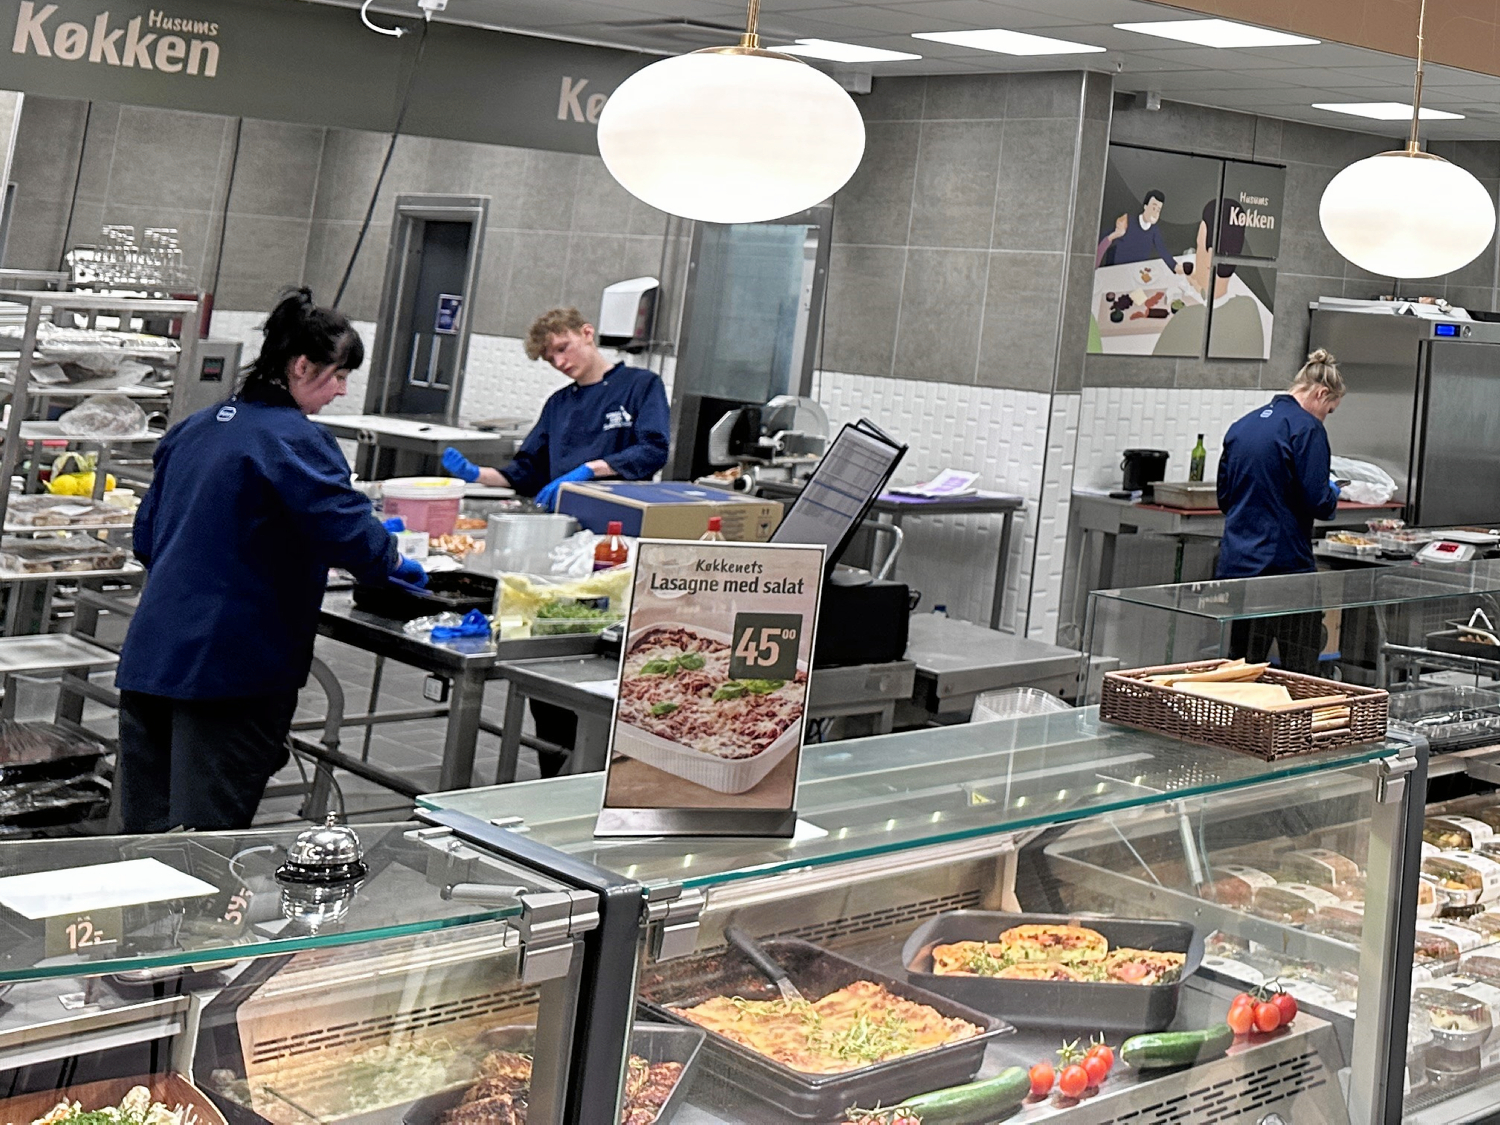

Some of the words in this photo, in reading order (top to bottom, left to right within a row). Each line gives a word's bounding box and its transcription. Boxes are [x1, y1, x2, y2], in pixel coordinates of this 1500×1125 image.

[149, 9, 219, 36] Husums
[12, 0, 220, 77] Køkken
[1229, 206, 1275, 229] Køkken
[695, 558, 763, 574] Køkkenets
[650, 572, 719, 595] Lasagne
[723, 576, 759, 593] med
[763, 577, 804, 595] salat
